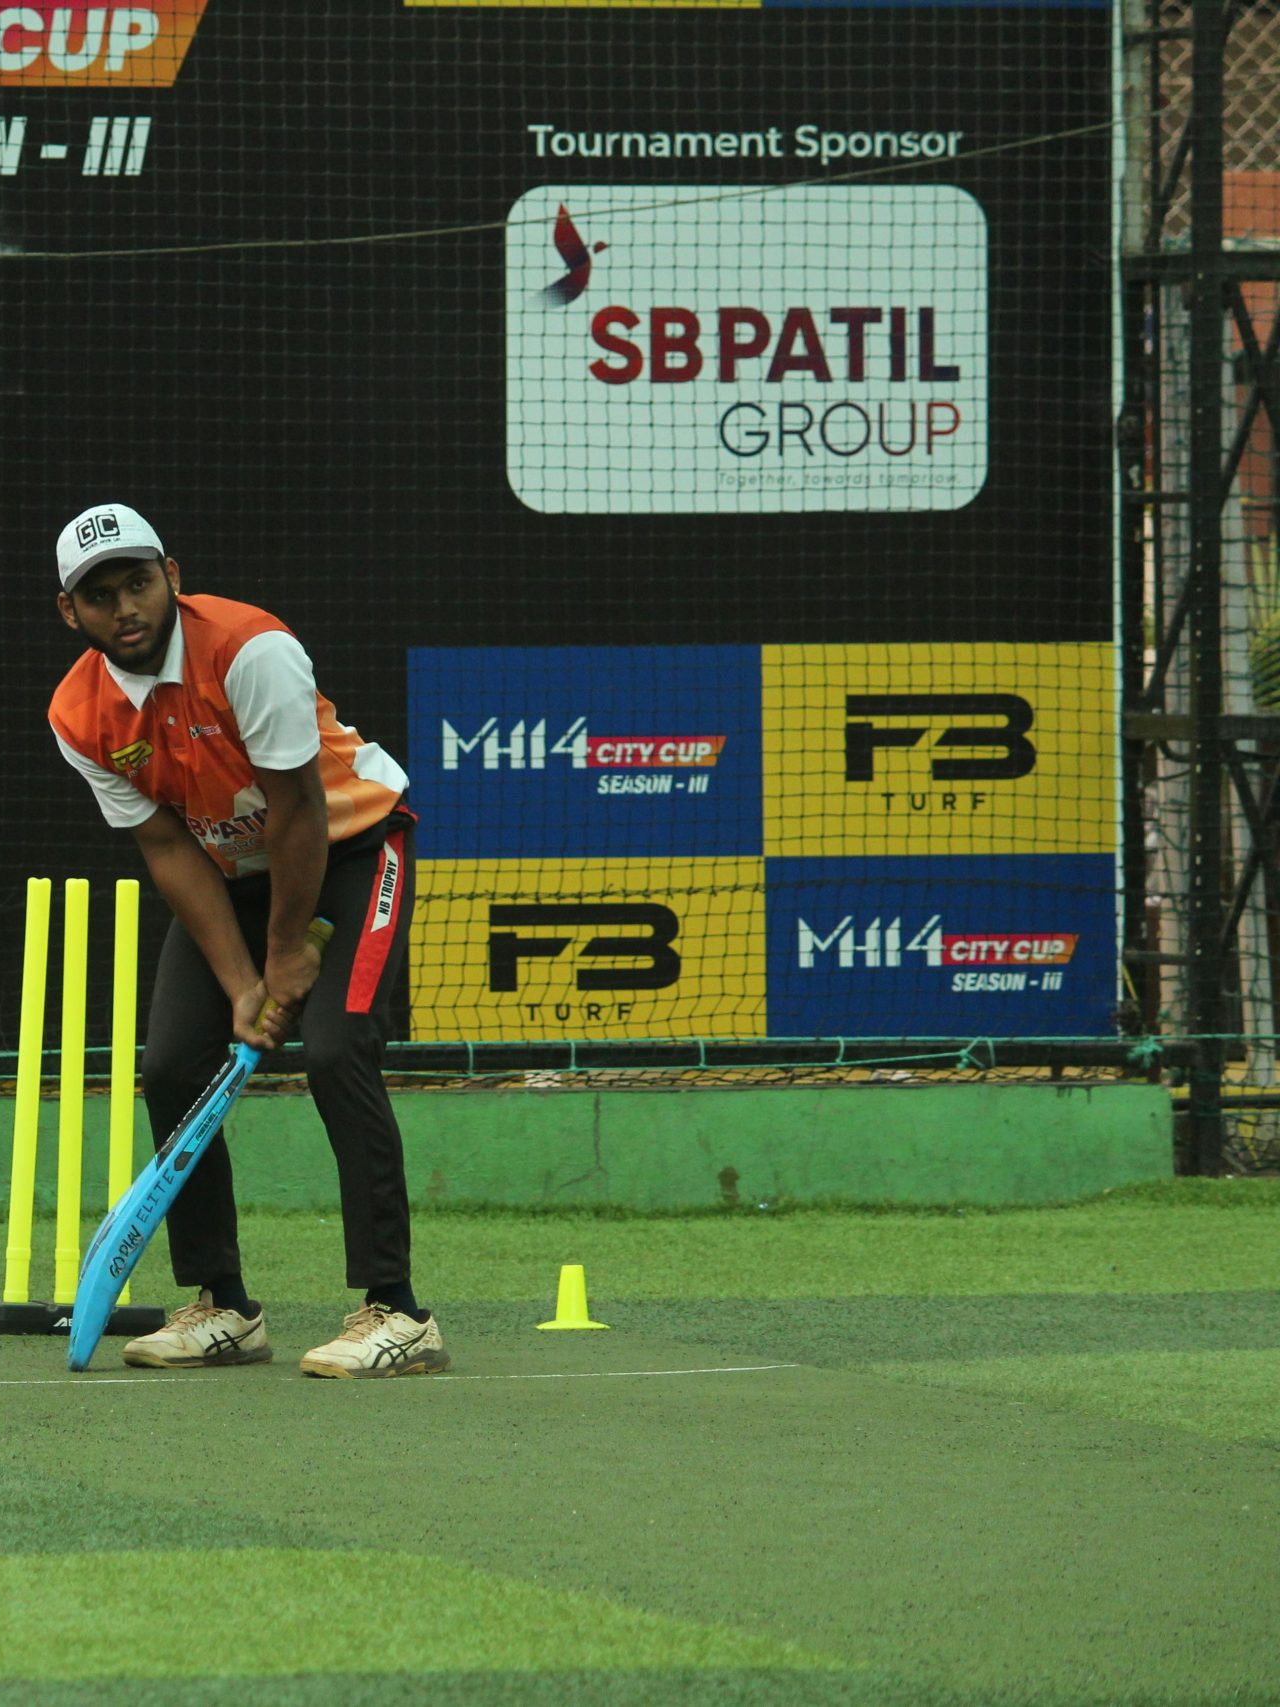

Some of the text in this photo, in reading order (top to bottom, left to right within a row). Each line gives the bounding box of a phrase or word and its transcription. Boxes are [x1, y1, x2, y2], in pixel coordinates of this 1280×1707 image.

[82, 117, 151, 176] III
[528, 125, 963, 165] Tournament Sponsor
[720, 402, 960, 457] GROUP
[804, 472, 870, 485] towards
[596, 743, 654, 763] CITY
[659, 743, 712, 763] CUP
[597, 775, 672, 794] SEASON
[881, 793, 986, 811] TURF
[380, 859, 397, 899] TROPHY
[950, 941, 1009, 961] CITY
[1013, 940, 1066, 961] CUP
[951, 972, 1026, 991] SEASON
[525, 1003, 631, 1021] TURF
[136, 1167, 175, 1224] ELITE
